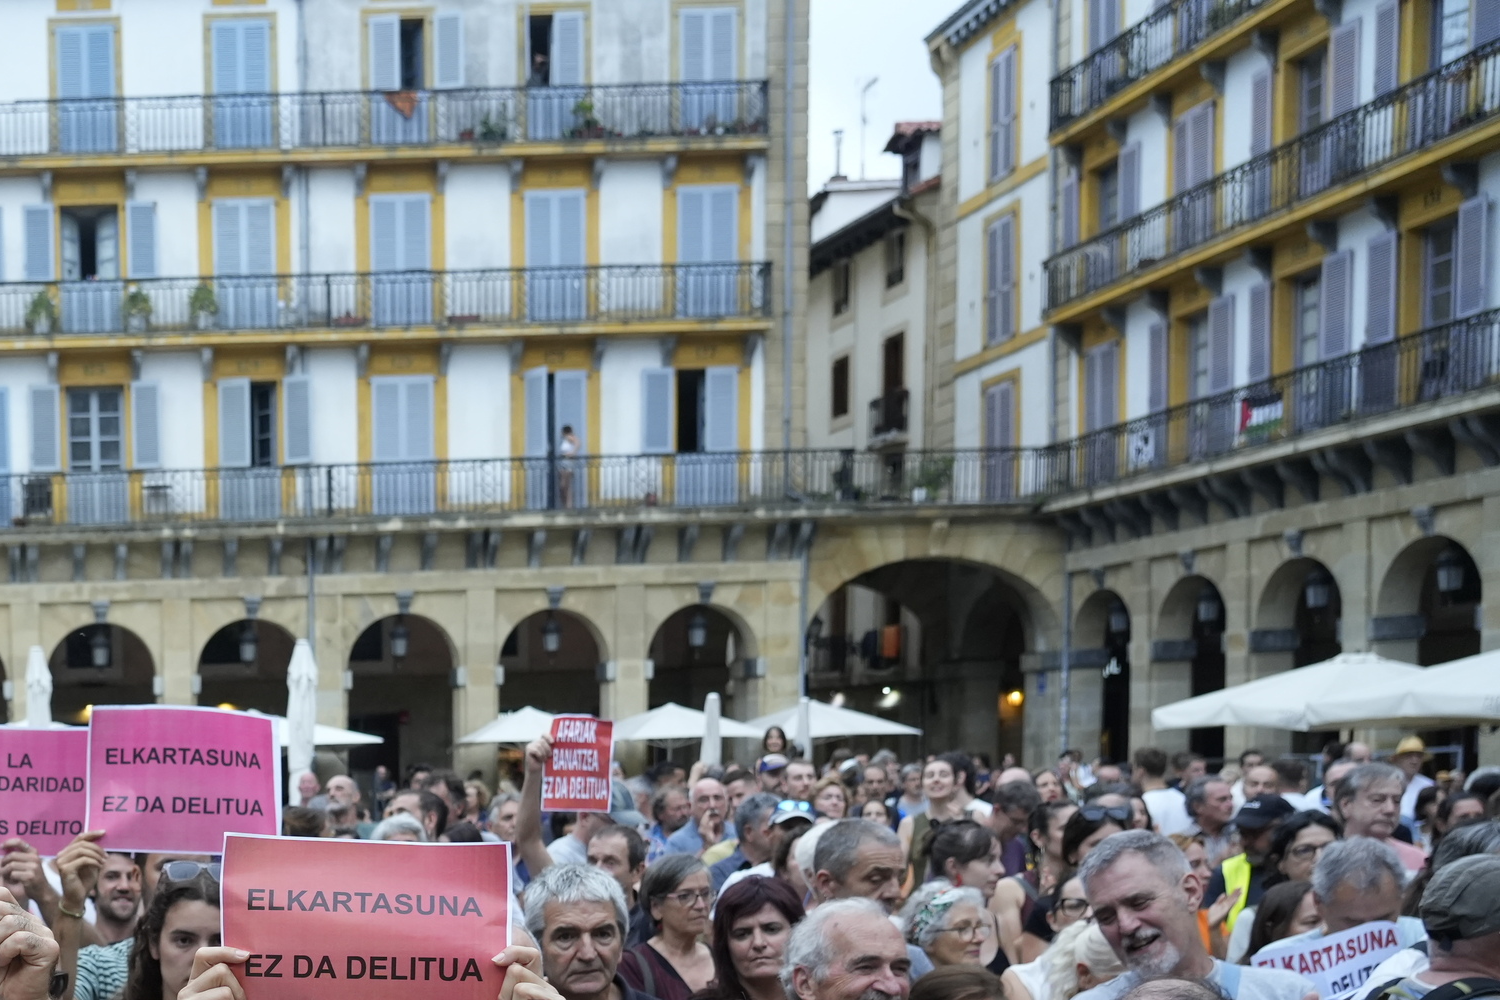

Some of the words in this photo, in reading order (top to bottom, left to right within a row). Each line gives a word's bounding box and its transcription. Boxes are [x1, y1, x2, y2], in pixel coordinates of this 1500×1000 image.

[556, 720, 598, 743] AFARIAK
[8, 753, 33, 769] LA
[105, 748, 261, 769] ELKARTASUNA
[553, 749, 599, 771] BANATZEA
[542, 776, 554, 799] EZ
[555, 776, 569, 799] DA
[570, 776, 608, 799] DELITUA
[102, 796, 128, 812] EZ
[135, 796, 165, 813] DA
[172, 796, 263, 816] DELITUA
[16, 820, 83, 836] DELITO
[247, 888, 484, 917] ELKARTASUNA
[245, 954, 283, 978] EZ
[293, 955, 337, 979] DA
[347, 956, 483, 982] DELITUA
